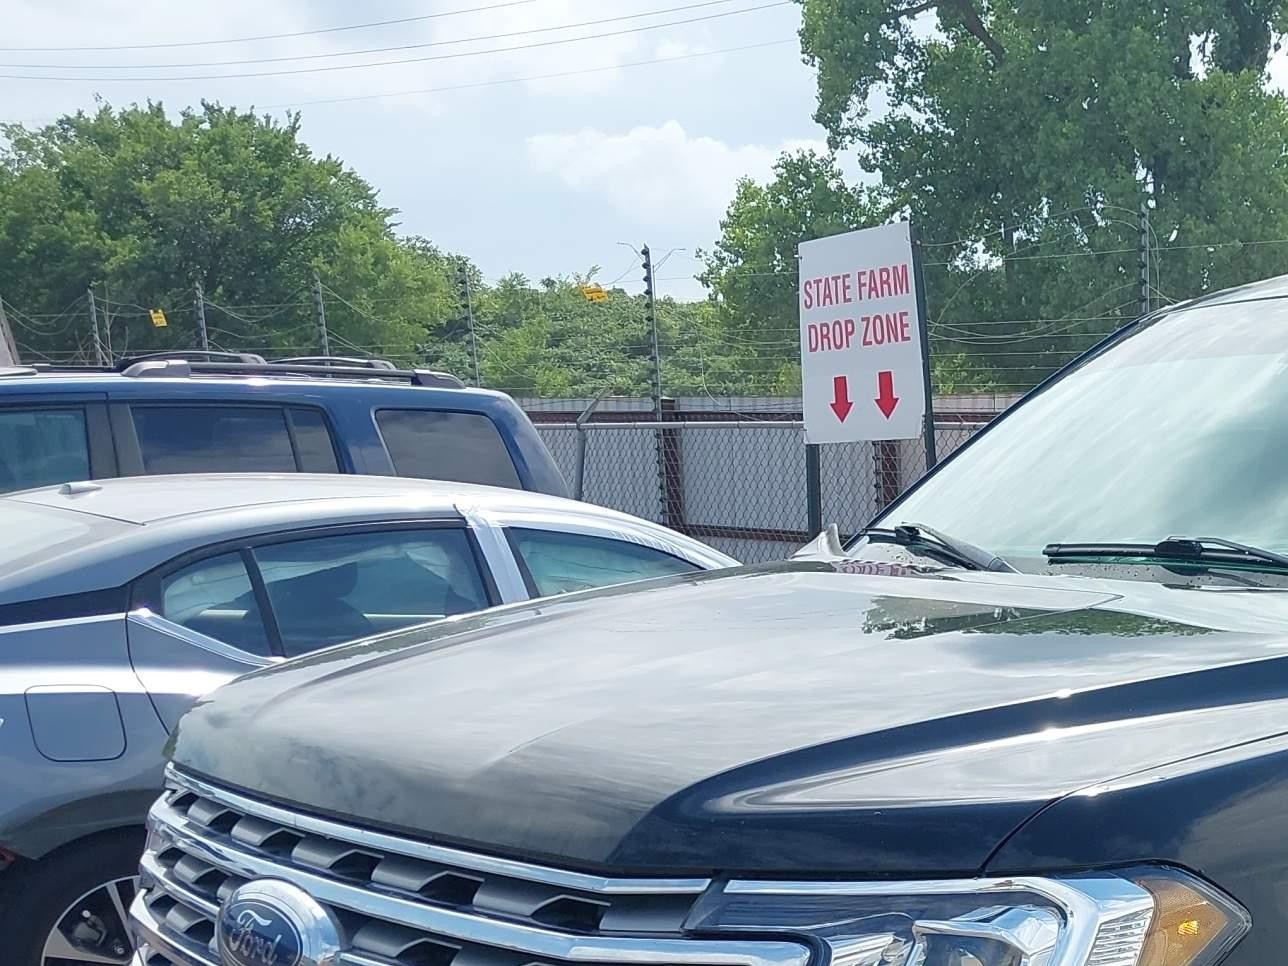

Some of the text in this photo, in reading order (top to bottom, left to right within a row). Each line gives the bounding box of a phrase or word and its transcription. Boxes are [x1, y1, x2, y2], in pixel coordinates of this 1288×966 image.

[803, 264, 910, 310] STATE FARM
[807, 311, 911, 353] DROP ZONE
[229, 908, 282, 966] Ford
